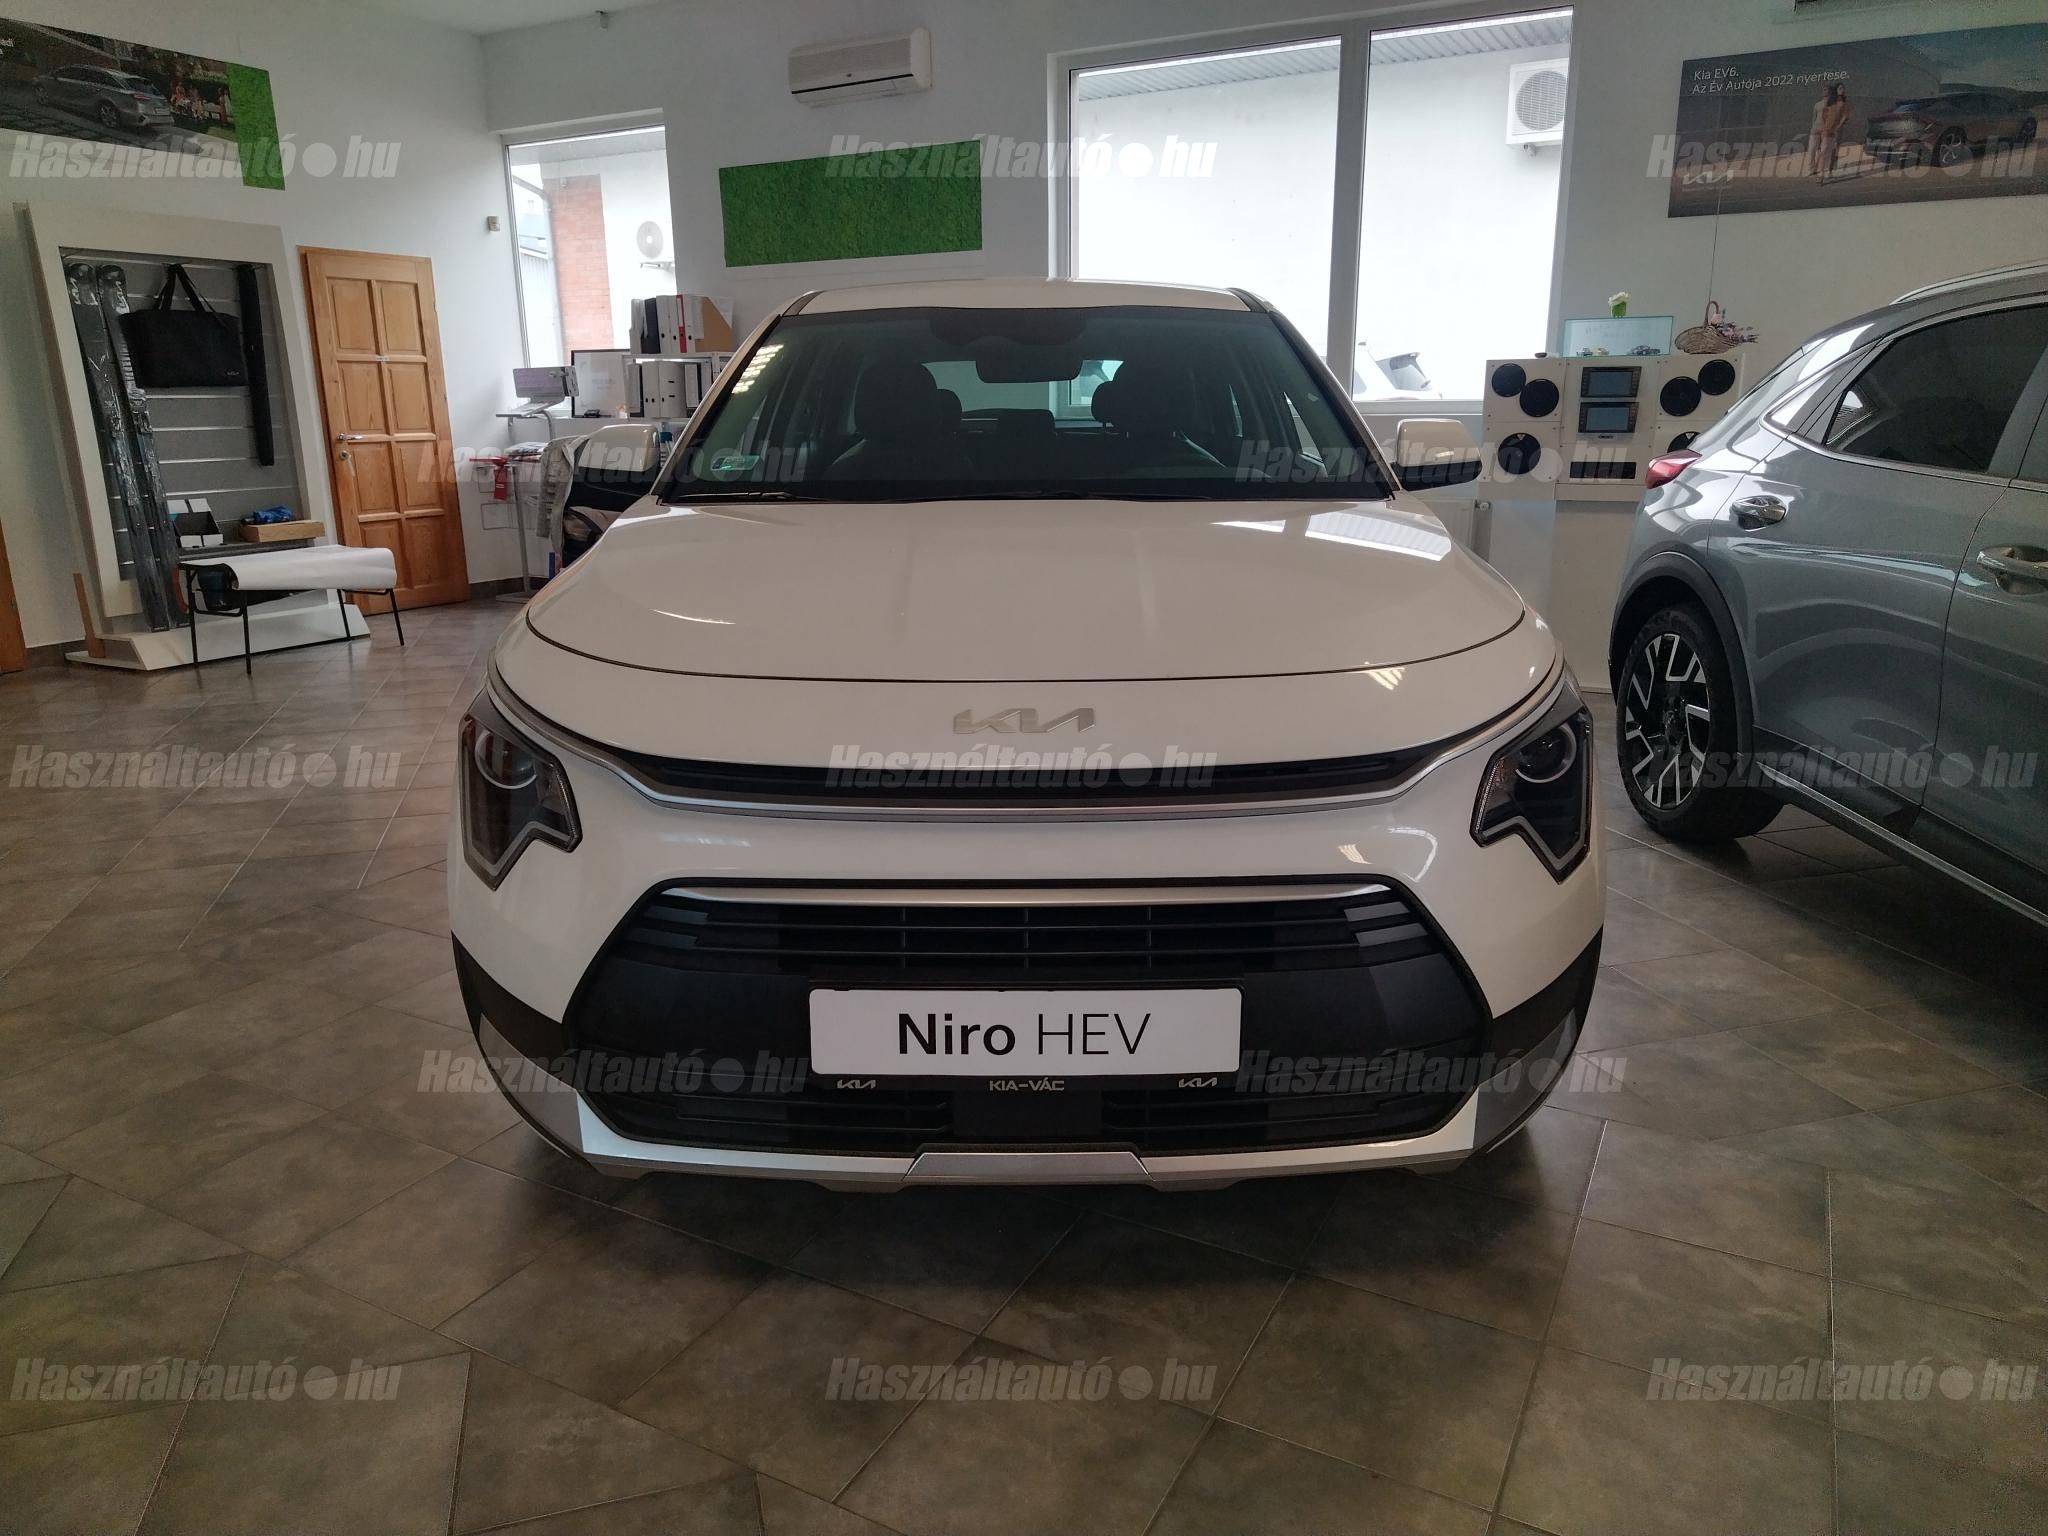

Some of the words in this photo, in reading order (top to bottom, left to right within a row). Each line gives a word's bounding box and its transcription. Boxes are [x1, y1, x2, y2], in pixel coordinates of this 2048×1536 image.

[1692, 83, 1706, 95] Az
[1709, 81, 1723, 93] Év
[1725, 79, 1762, 91] Autója
[1765, 74, 1793, 87] 2022
[1796, 70, 1850, 86] nyertese.
[1694, 70, 1711, 81] Kia
[1714, 67, 1739, 79] EV6.
[953, 707, 1096, 735] KIA
[898, 1012, 1016, 1056] Niro
[1038, 1012, 1151, 1055] HEV
[989, 1076, 1065, 1092] KIA-VÁC
